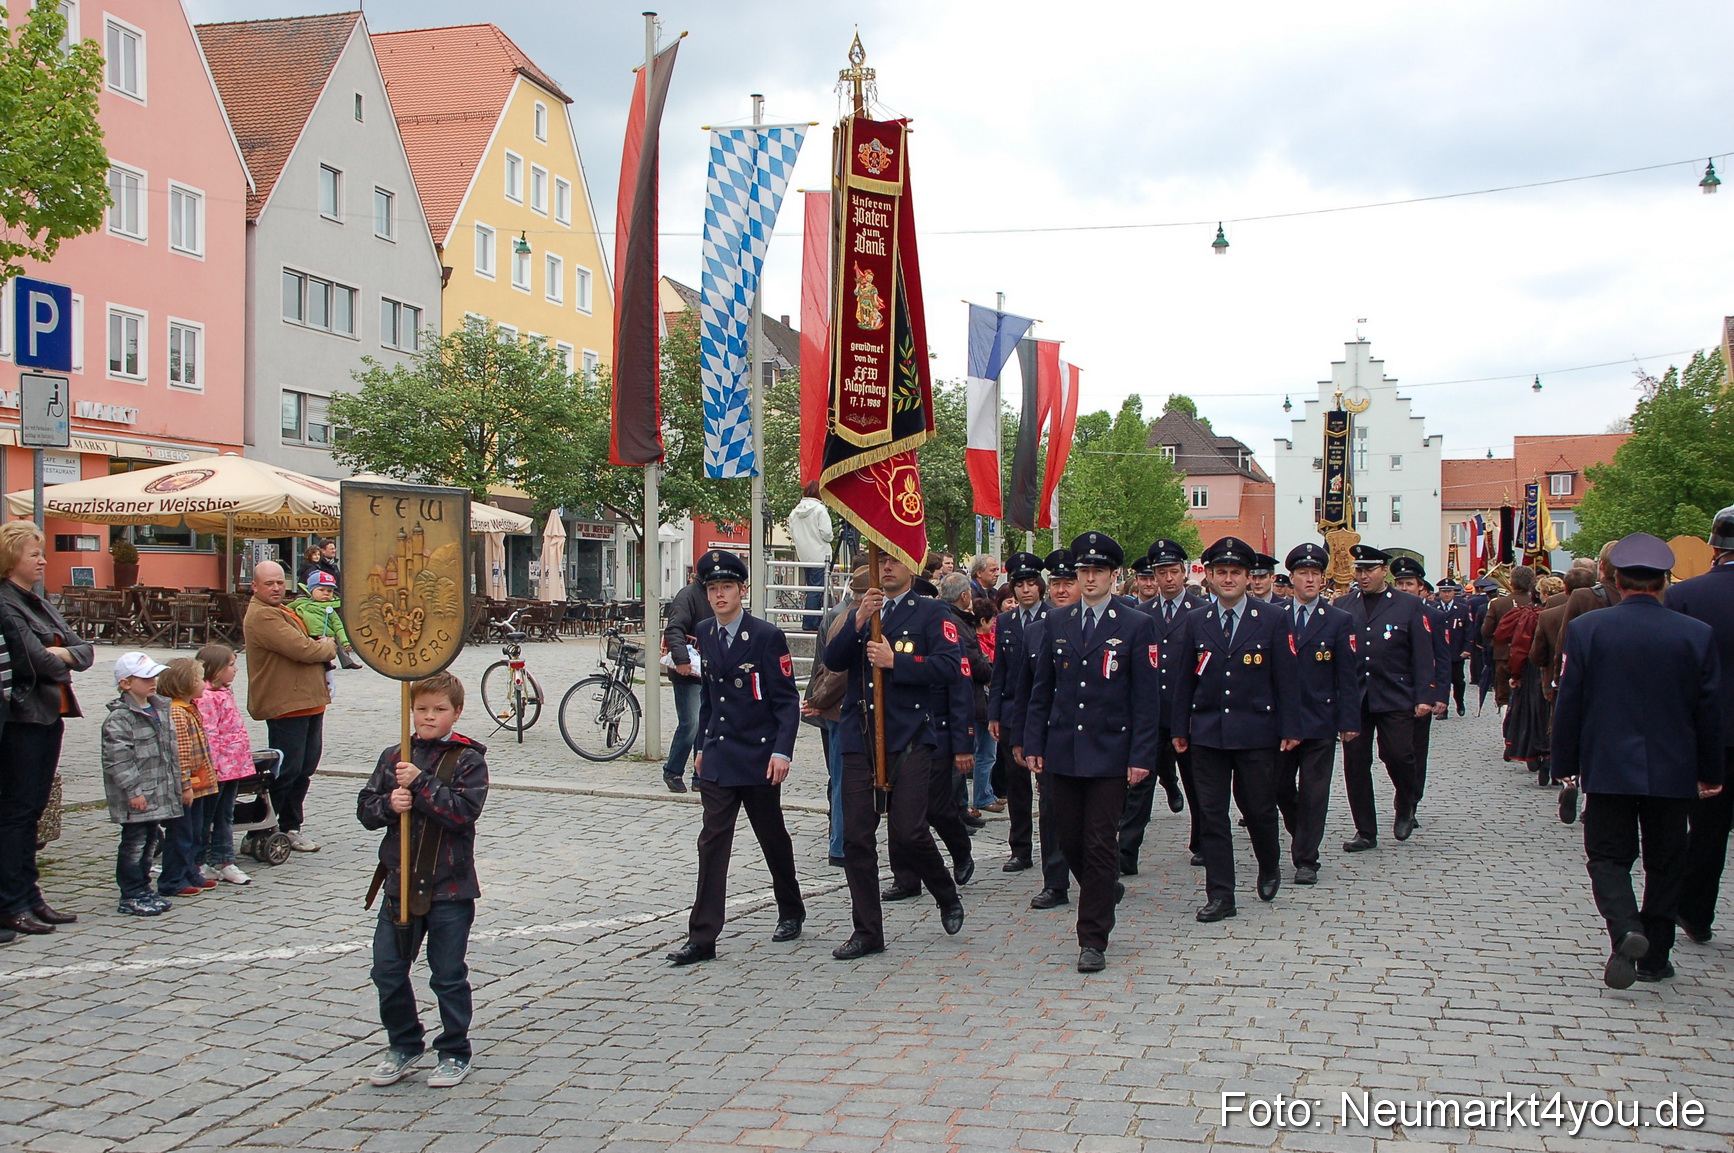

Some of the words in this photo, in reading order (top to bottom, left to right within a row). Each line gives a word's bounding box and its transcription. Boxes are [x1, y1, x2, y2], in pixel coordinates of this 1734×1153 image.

[852, 207, 889, 228] Paten
[862, 228, 880, 238] zum
[854, 233, 887, 256] Dank
[29, 291, 60, 357] P
[850, 342, 884, 353] gewidmet
[853, 354, 867, 363] von
[867, 354, 878, 364] der
[852, 366, 878, 382] FFW
[74, 400, 139, 424] MARKT
[74, 439, 108, 452] MARKT
[48, 498, 155, 514] Franziskaner
[160, 497, 240, 512] Weissbier
[355, 624, 452, 667] PARSBERG
